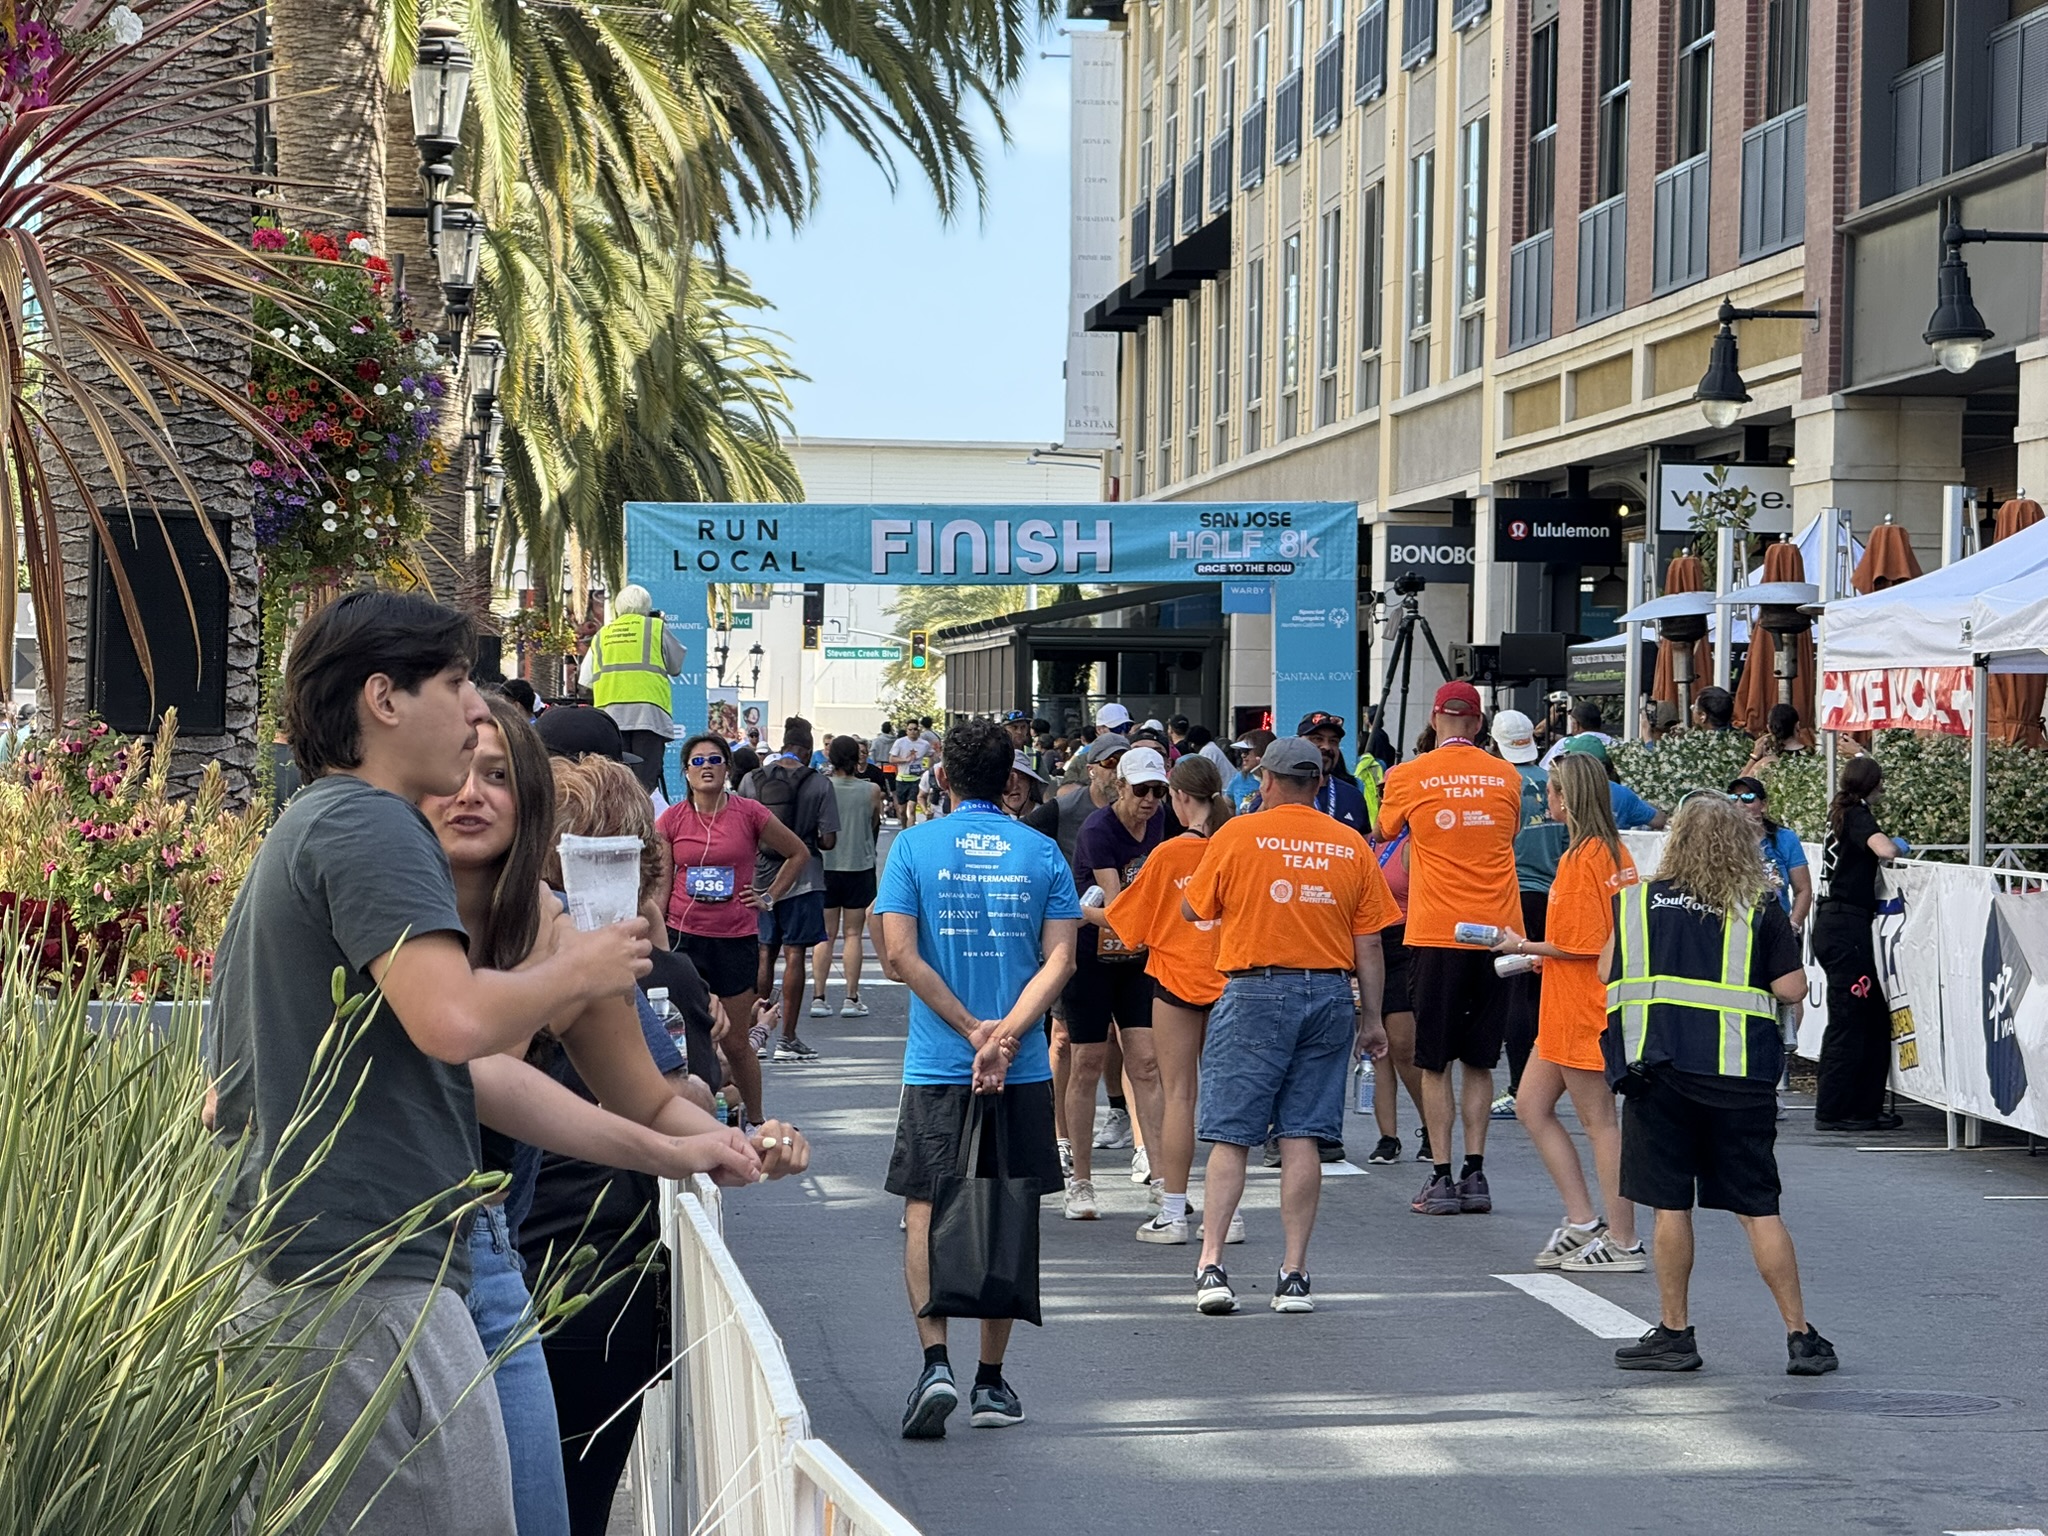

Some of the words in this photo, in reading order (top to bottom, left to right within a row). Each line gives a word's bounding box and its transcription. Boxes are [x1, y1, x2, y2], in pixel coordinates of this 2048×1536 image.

[1068, 419, 1082, 428] LB
[1083, 420, 1115, 429] STEAK
[1670, 490, 1792, 509] vce.
[1200, 512, 1239, 528] SAN
[1243, 511, 1292, 528] JOSE
[698, 519, 778, 541] RUN
[1532, 522, 1610, 538] lululemon
[871, 519, 1112, 575] FINISH
[1169, 530, 1264, 560] HALF
[1279, 529, 1320, 559] 8k
[673, 549, 806, 572] LOCAL
[1390, 544, 1476, 565] BONOBO
[1197, 564, 1227, 573] RACE
[1228, 563, 1243, 573] TO
[1244, 563, 1265, 573] THE
[1266, 563, 1292, 573] ROW
[1230, 586, 1266, 595] WARBY
[667, 622, 702, 630] MANENTE
[826, 649, 856, 658] Stevens
[857, 649, 880, 658] Creek
[881, 650, 899, 658] Blvd
[1278, 671, 1326, 681] SANTANA
[1328, 671, 1353, 681] ROW
[1420, 775, 1506, 790] VOLUNTEER
[1443, 787, 1485, 798] TEAM
[955, 837, 991, 851] HALF
[996, 840, 1012, 851] 8k
[966, 833, 982, 841] SAN
[983, 833, 1001, 842] JOSE
[1255, 837, 1355, 860] VOLUNTEER
[1282, 854, 1329, 871] TEAM
[695, 879, 725, 892] 936
[952, 873, 977, 882] KAISER
[978, 874, 1029, 884] PERMANENTE
[1299, 894, 1337, 906] OUTFITTERS
